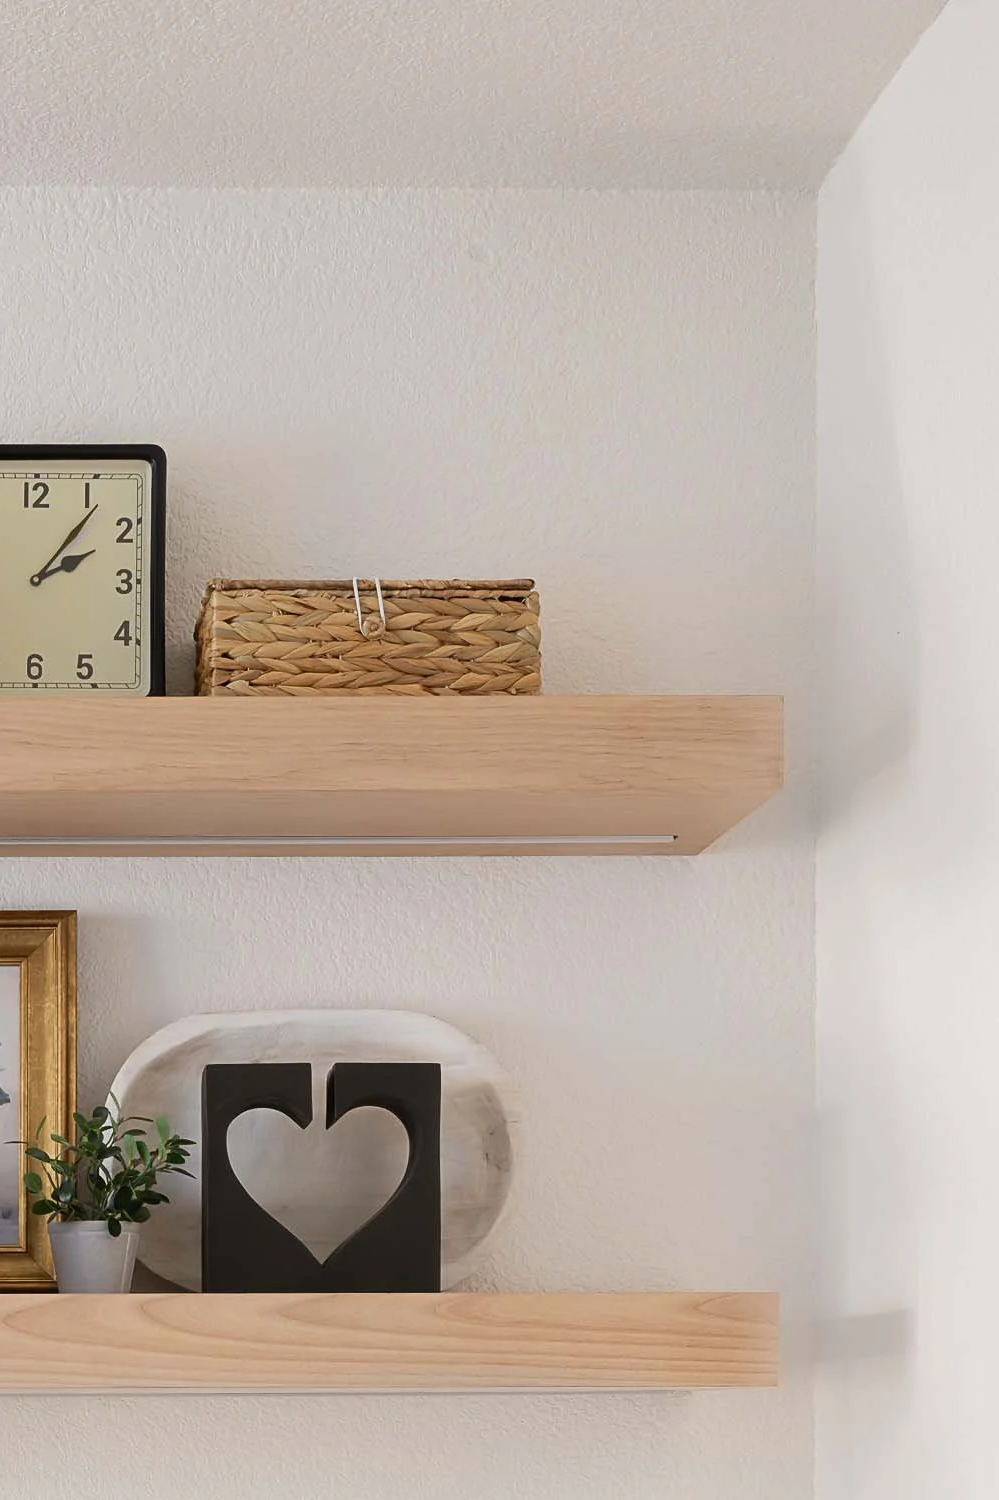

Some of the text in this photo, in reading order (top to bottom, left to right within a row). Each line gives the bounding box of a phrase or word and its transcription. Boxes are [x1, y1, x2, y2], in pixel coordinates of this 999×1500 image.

[23, 482, 50, 508] 12
[84, 482, 90, 508] 1
[115, 517, 134, 543] 2
[115, 568, 133, 595] 3
[113, 620, 133, 646] 4
[26, 653, 43, 680] 6
[76, 653, 94, 680] 5
